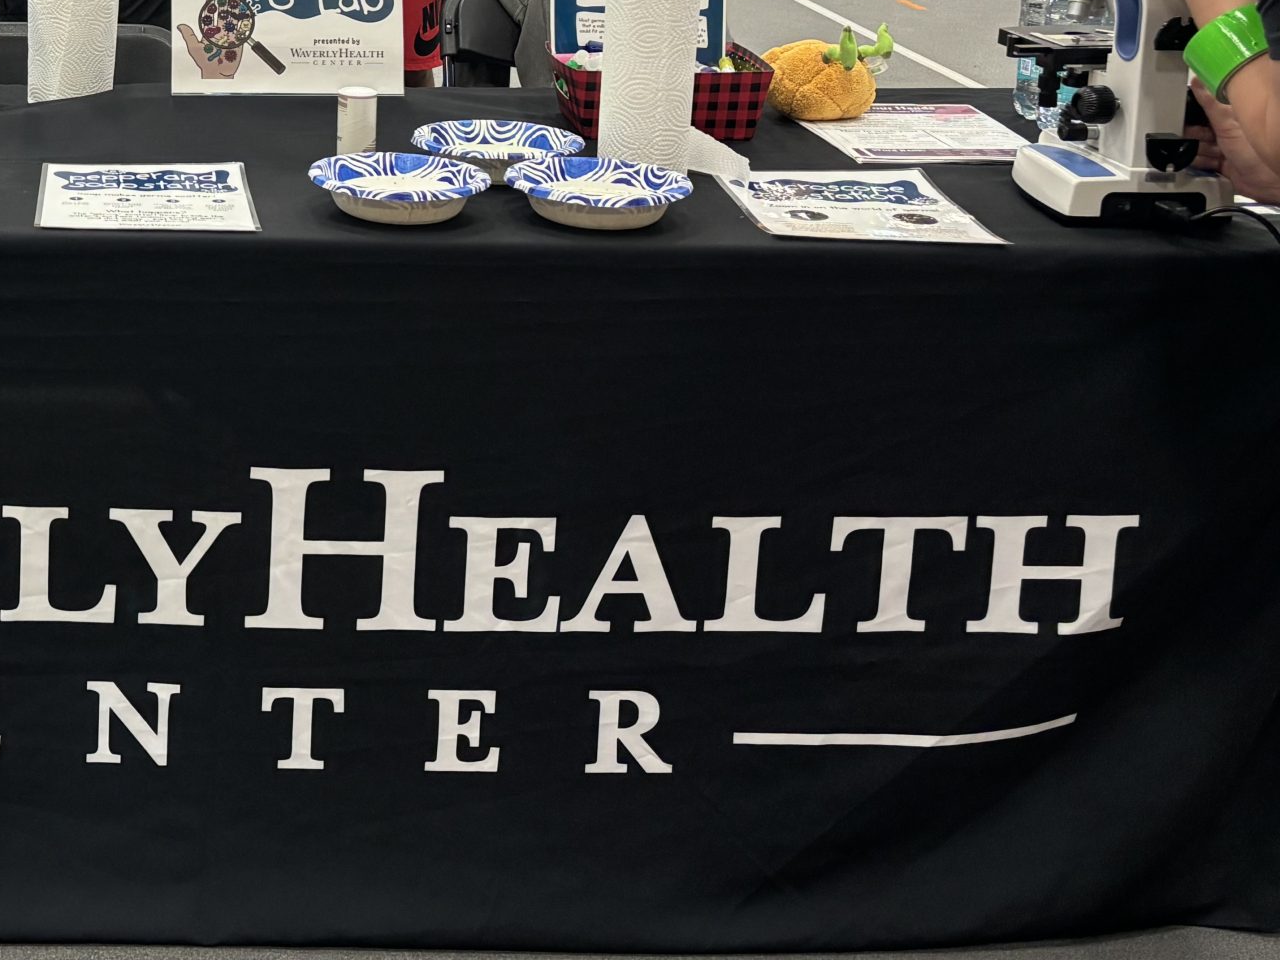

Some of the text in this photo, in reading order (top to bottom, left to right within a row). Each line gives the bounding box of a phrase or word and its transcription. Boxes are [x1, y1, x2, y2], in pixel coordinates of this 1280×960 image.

[313, 37, 361, 46] presented by
[69, 170, 217, 183] pepper and
[68, 180, 236, 190] soap station
[808, 190, 910, 202] station
